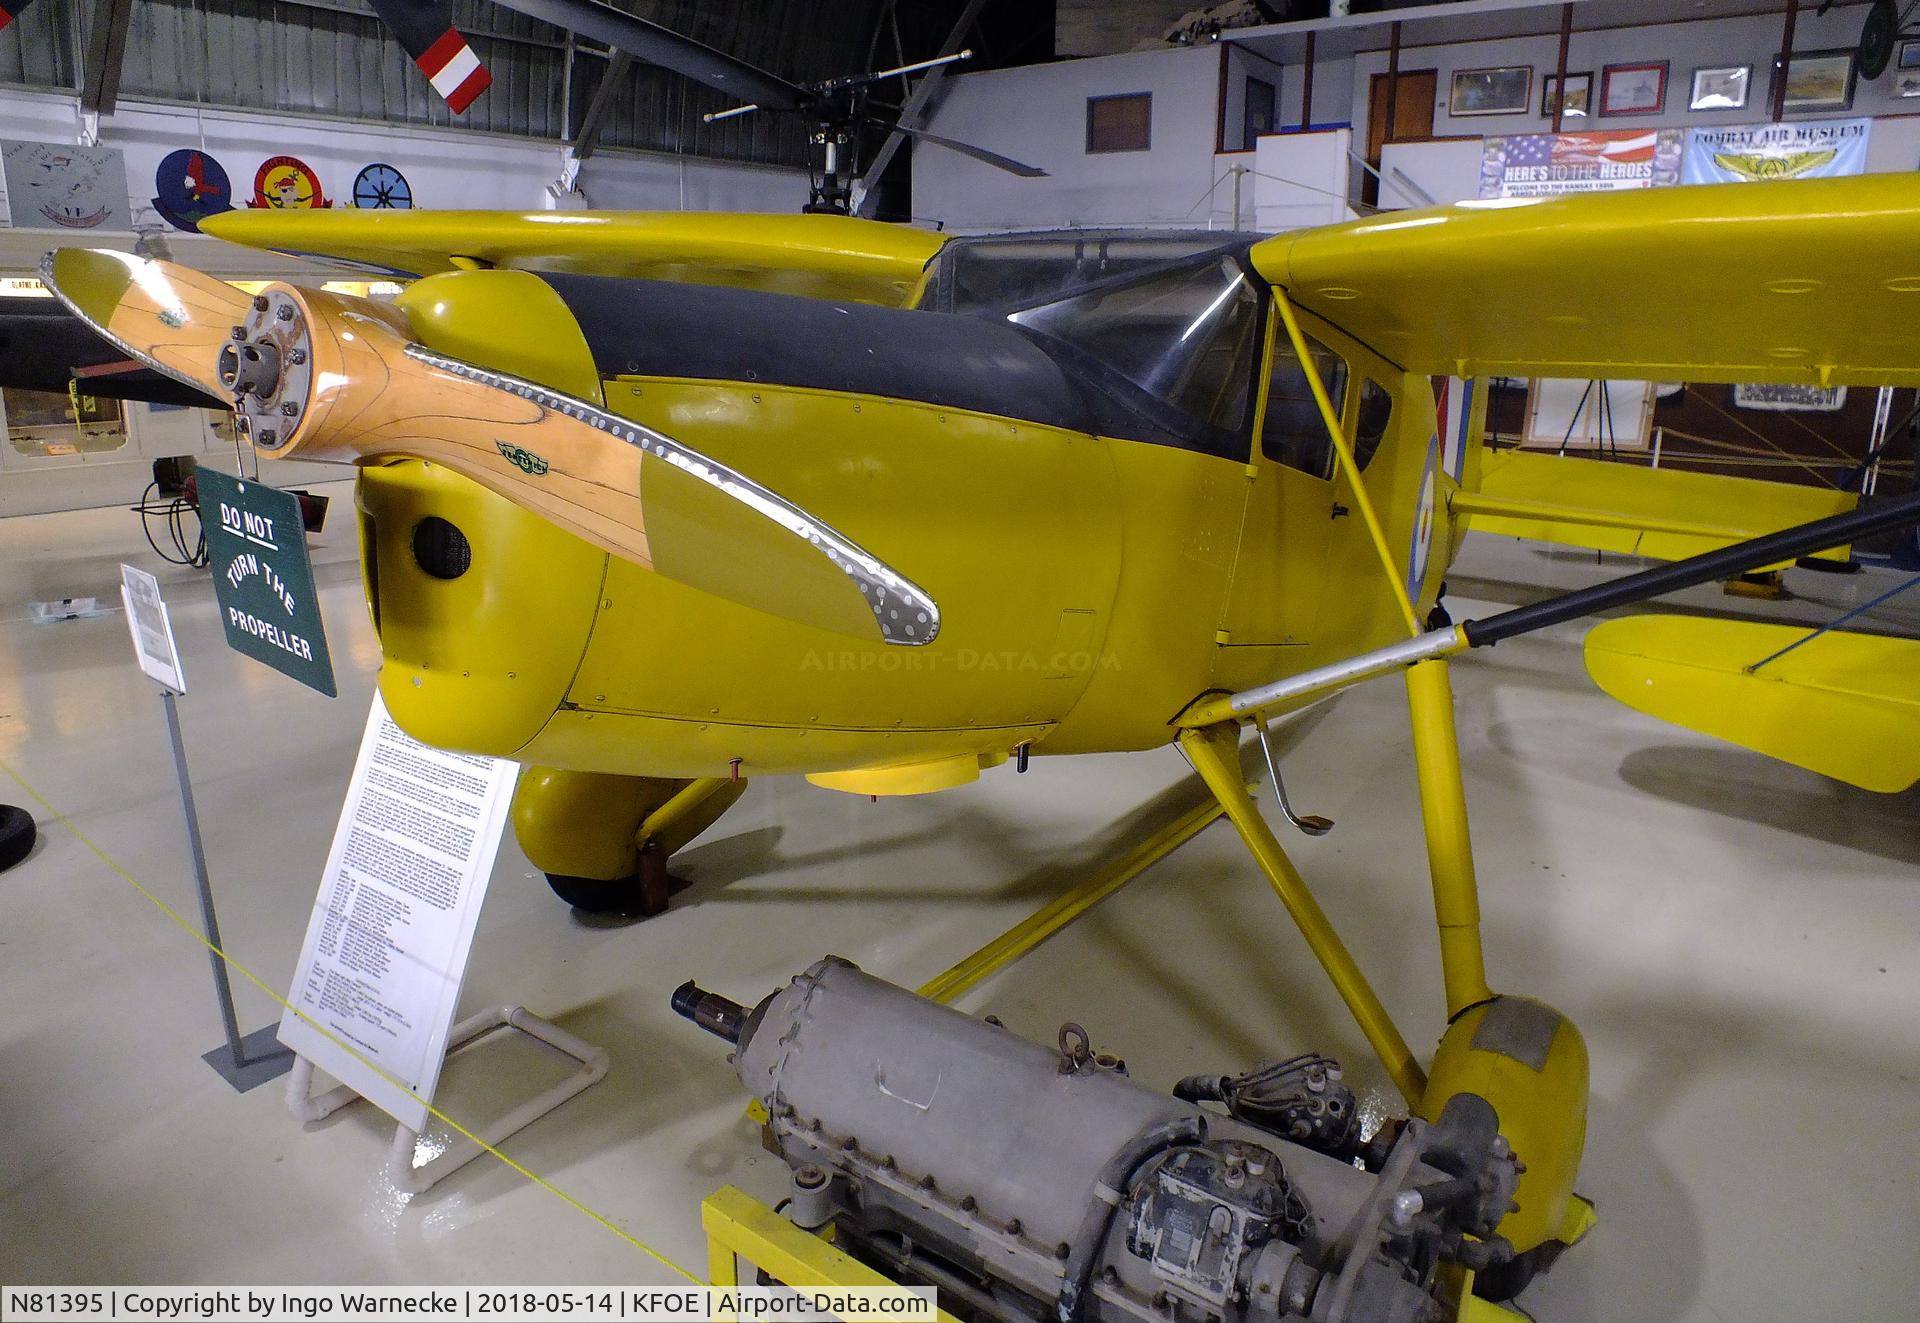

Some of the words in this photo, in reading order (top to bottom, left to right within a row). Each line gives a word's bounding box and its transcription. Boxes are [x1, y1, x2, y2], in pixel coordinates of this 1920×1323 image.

[1695, 131, 1754, 144] COMBAT
[1760, 129, 1789, 141] AIR
[1794, 125, 1865, 140] MUSEUM
[1504, 165, 1549, 182] HERE'S
[1551, 164, 1568, 181] TO
[1571, 163, 1598, 180] THE
[1600, 162, 1652, 179] HEROES
[220, 502, 241, 530] DO
[243, 510, 274, 541] NOT
[227, 553, 259, 589] TURN
[262, 562, 295, 616] THE
[228, 606, 313, 662] PROPELLER
